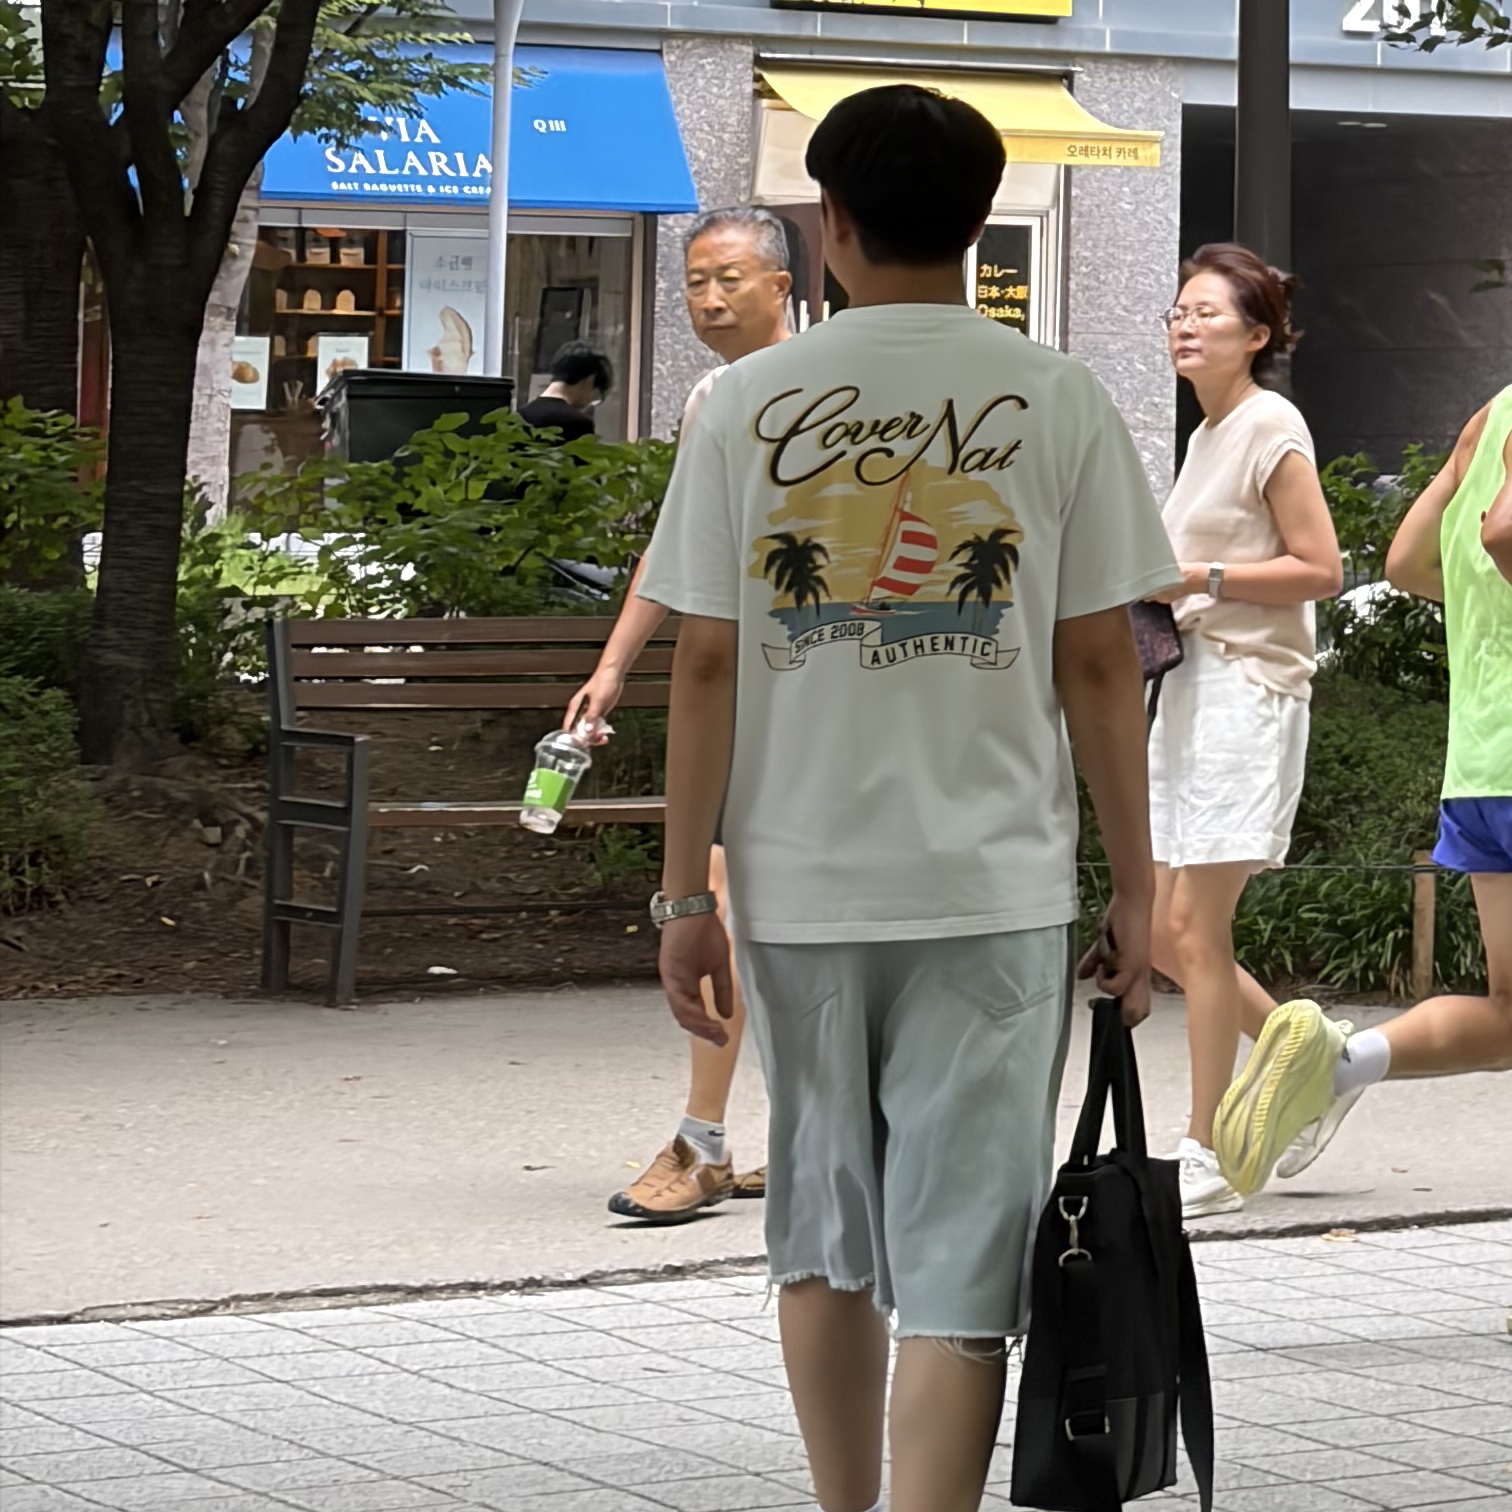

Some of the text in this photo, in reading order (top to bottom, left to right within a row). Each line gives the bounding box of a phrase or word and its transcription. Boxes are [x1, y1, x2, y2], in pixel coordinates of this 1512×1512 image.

[1066, 144, 1139, 161] 오레타치 카레
[324, 147, 493, 178] SALARIA
[363, 182, 422, 193] BAGUETTE
[439, 185, 459, 194] ICE
[979, 263, 1019, 278] カレー
[831, 621, 866, 640] 2008
[870, 634, 993, 667] AUTHENTIC
